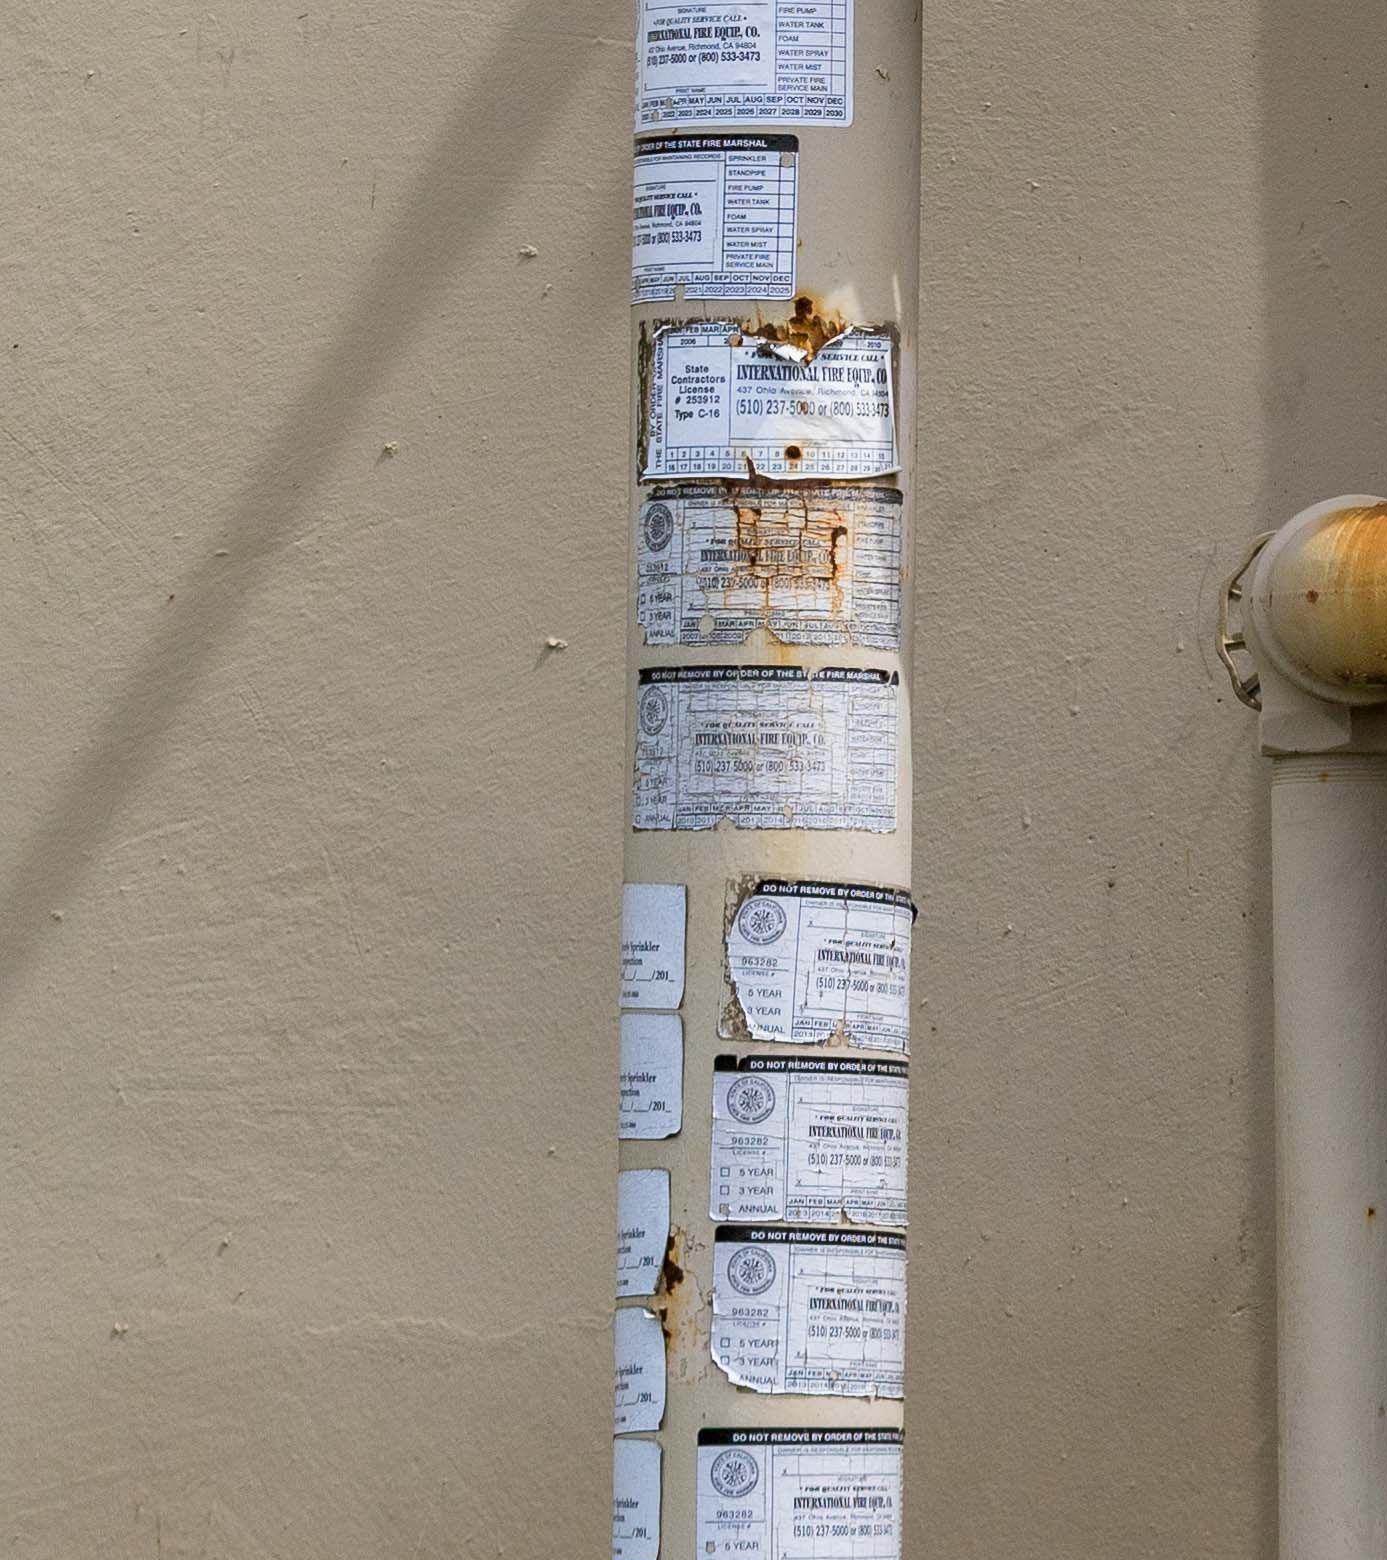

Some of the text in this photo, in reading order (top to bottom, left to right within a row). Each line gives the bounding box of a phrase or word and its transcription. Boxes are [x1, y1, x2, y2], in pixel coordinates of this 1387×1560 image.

[694, 27, 713, 38] FIRE
[745, 26, 760, 37] CO.
[698, 51, 761, 64] (800) 533-3473
[827, 97, 843, 105] DEC
[826, 109, 843, 117] 2030
[672, 231, 701, 243] 533-3473
[685, 365, 709, 374] State
[736, 365, 844, 382] INTERNATIONAL FIRE
[671, 375, 726, 384] Contractors
[679, 386, 715, 394] License
[686, 395, 720, 404] 253912
[736, 399, 763, 416] (510)
[830, 402, 854, 417] (800)
[675, 409, 720, 421] Type C-16
[716, 1511, 753, 1519] 963282
